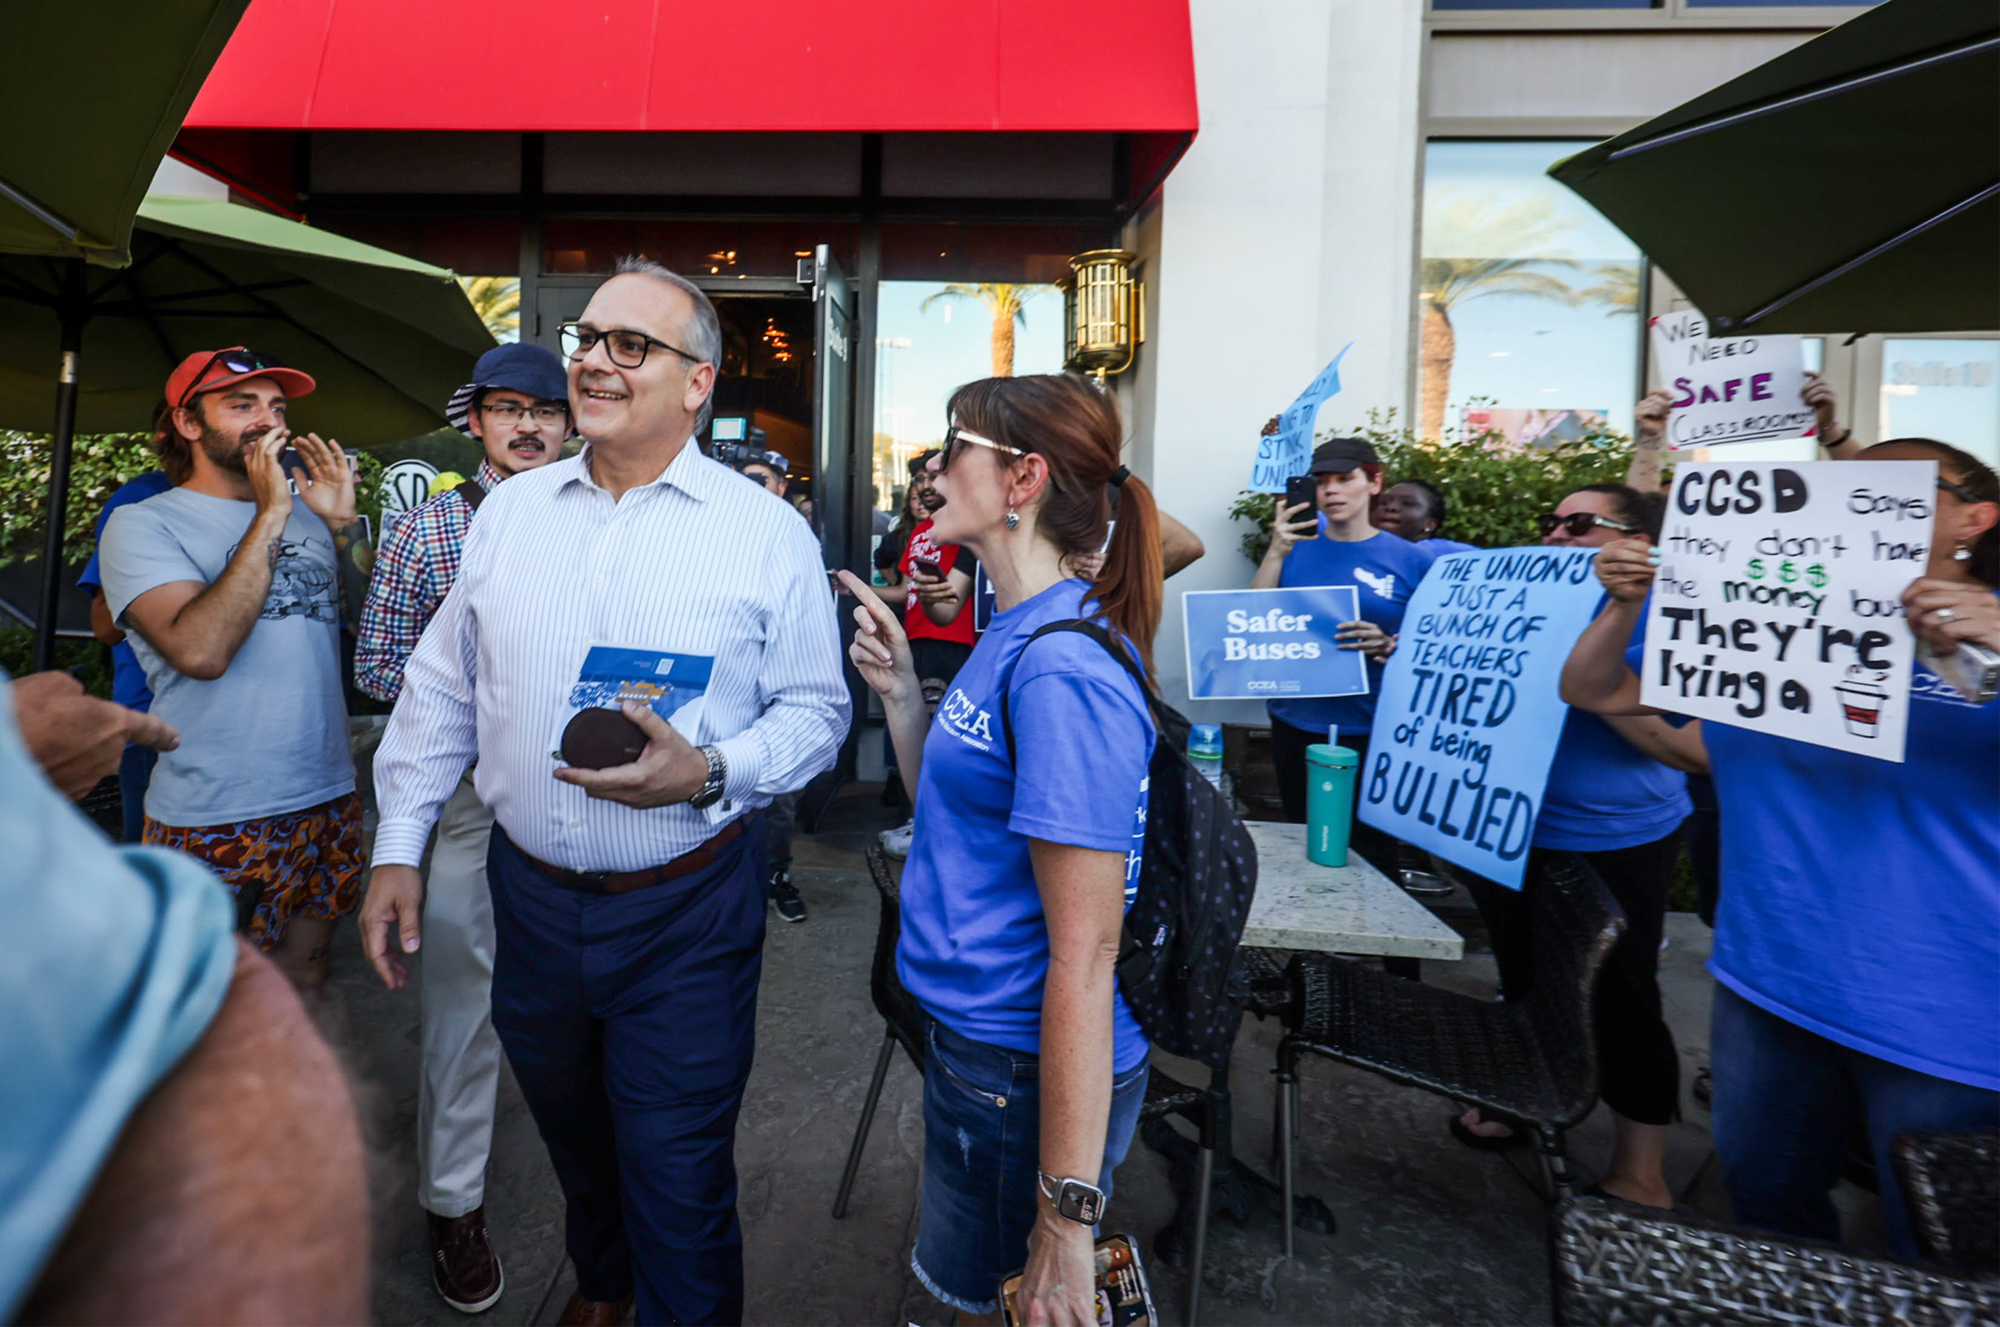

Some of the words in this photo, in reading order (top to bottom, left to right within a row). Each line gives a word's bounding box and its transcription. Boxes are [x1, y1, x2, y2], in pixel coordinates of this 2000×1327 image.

[1657, 315, 1704, 342] WE
[1688, 338, 1760, 365] NEED
[1671, 372, 1774, 408] SAFE
[1677, 468, 1809, 516] CCSD
[1668, 525, 1730, 563] they
[1756, 527, 1848, 558] don't
[1871, 530, 1926, 562] have
[1440, 558, 1481, 582] THE
[1485, 552, 1599, 585] UNION'S
[1439, 584, 1505, 611] JUST
[1505, 586, 1528, 611] A
[1659, 565, 1700, 598] the
[1722, 580, 1827, 616] money
[1226, 608, 1313, 634] Safer
[1417, 613, 1499, 639] BUNCH
[1502, 615, 1548, 643] OF
[1660, 607, 1893, 669] They're
[1223, 637, 1321, 662] Buses
[1411, 638, 1530, 679] TEACHERS
[1409, 667, 1516, 728] TIRED
[1660, 649, 1766, 718] lying
[1780, 679, 1811, 714] a
[943, 688, 993, 741] CCEA
[1394, 715, 1424, 748] of
[1430, 722, 1493, 790] being
[1367, 751, 1533, 861] BULLIED
